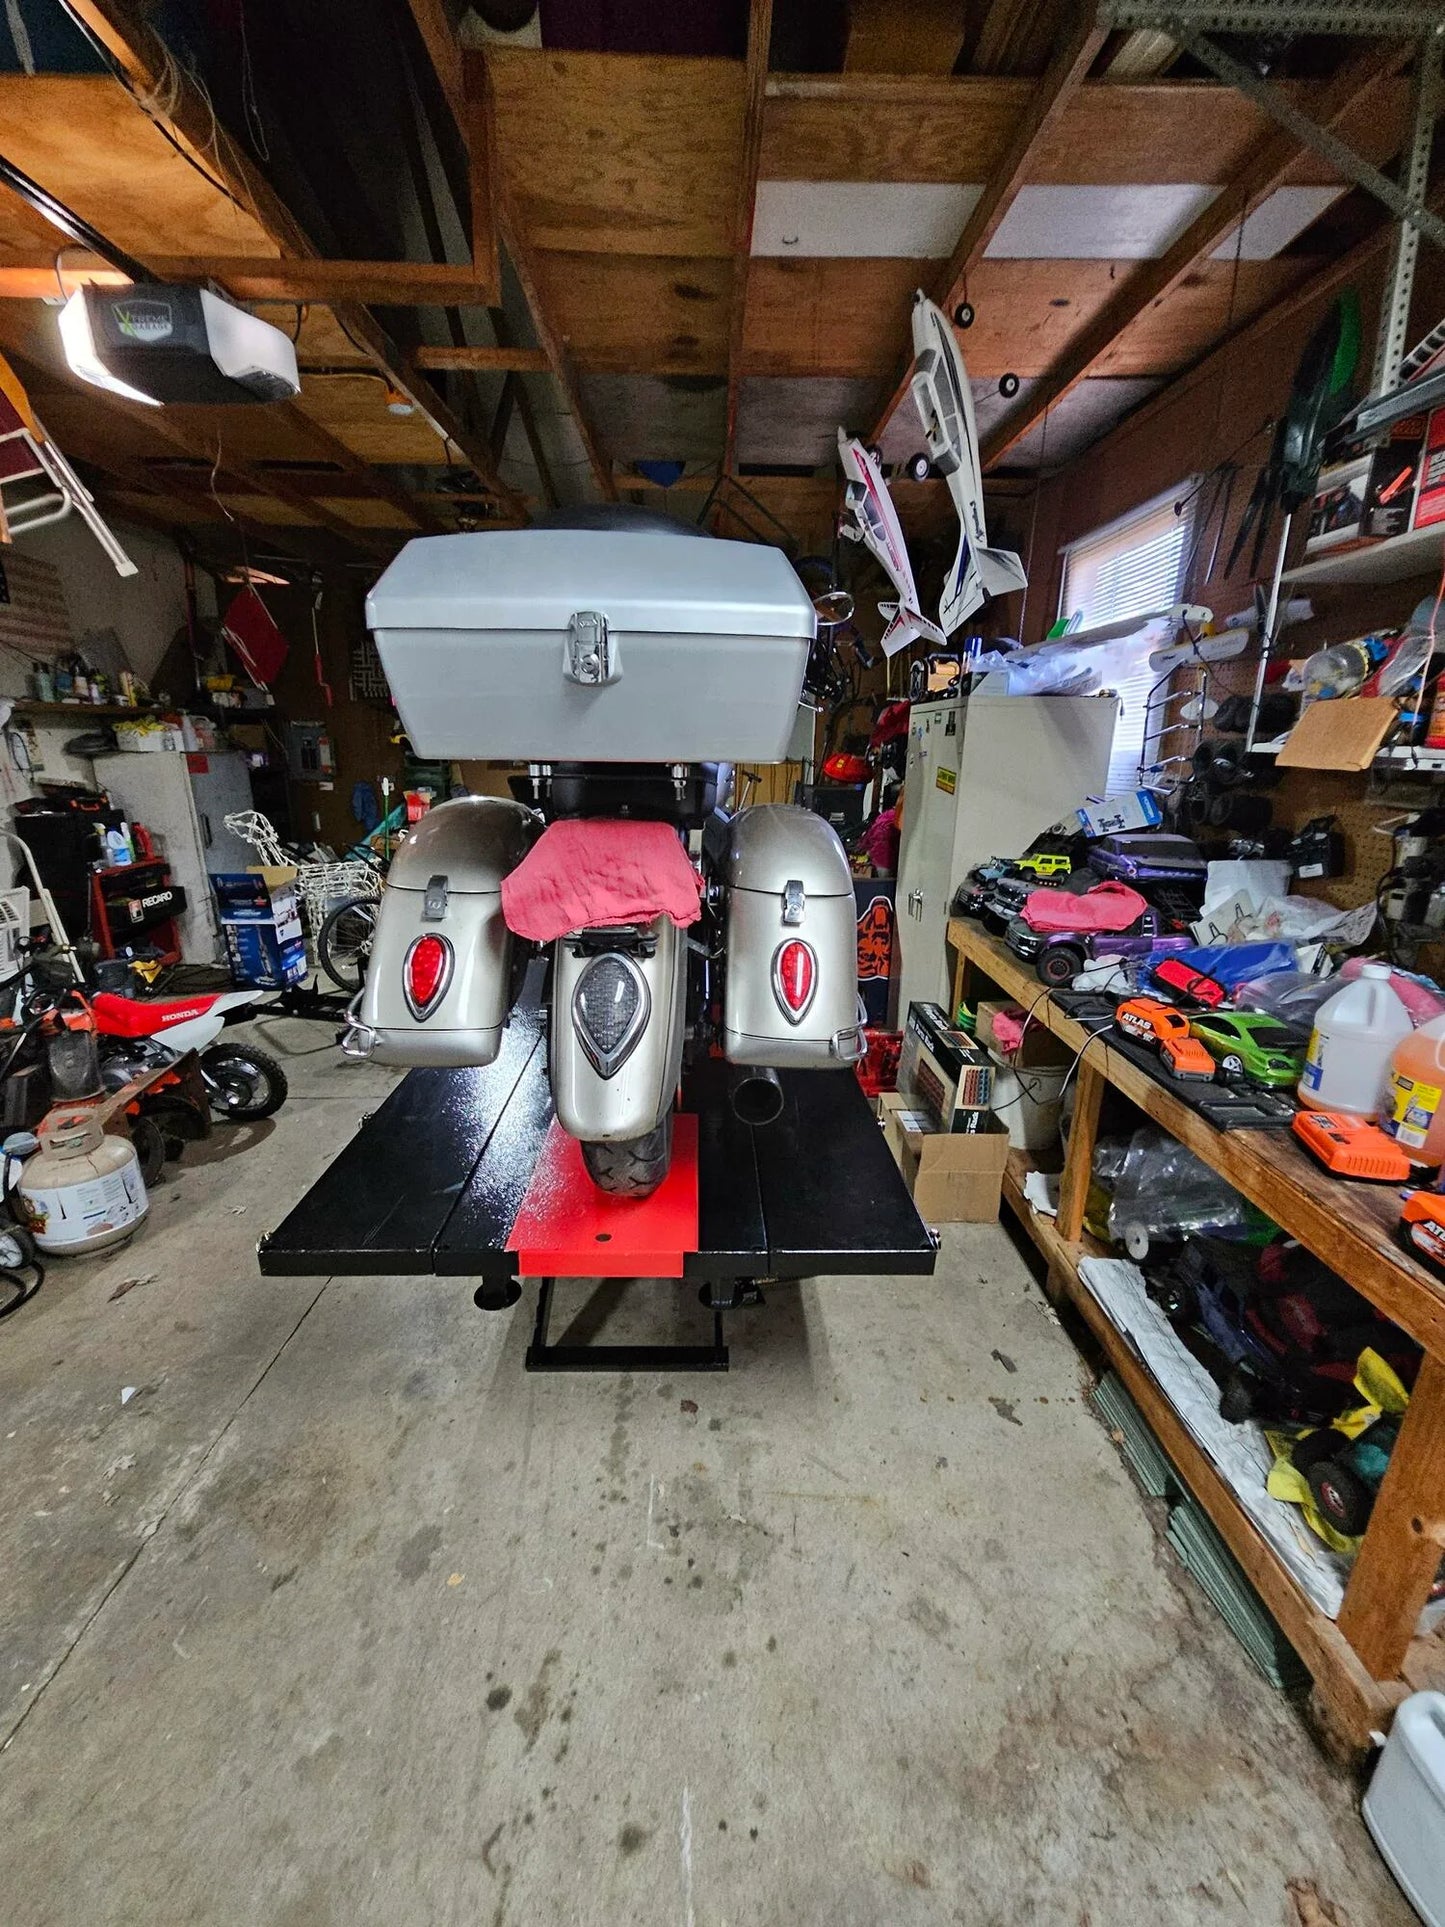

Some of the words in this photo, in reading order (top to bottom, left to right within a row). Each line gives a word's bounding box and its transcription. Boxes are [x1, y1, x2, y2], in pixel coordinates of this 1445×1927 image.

[142, 891, 173, 908] RECARO
[161, 1009, 199, 1022] HONDA
[1122, 1012, 1152, 1030] ATLAS
